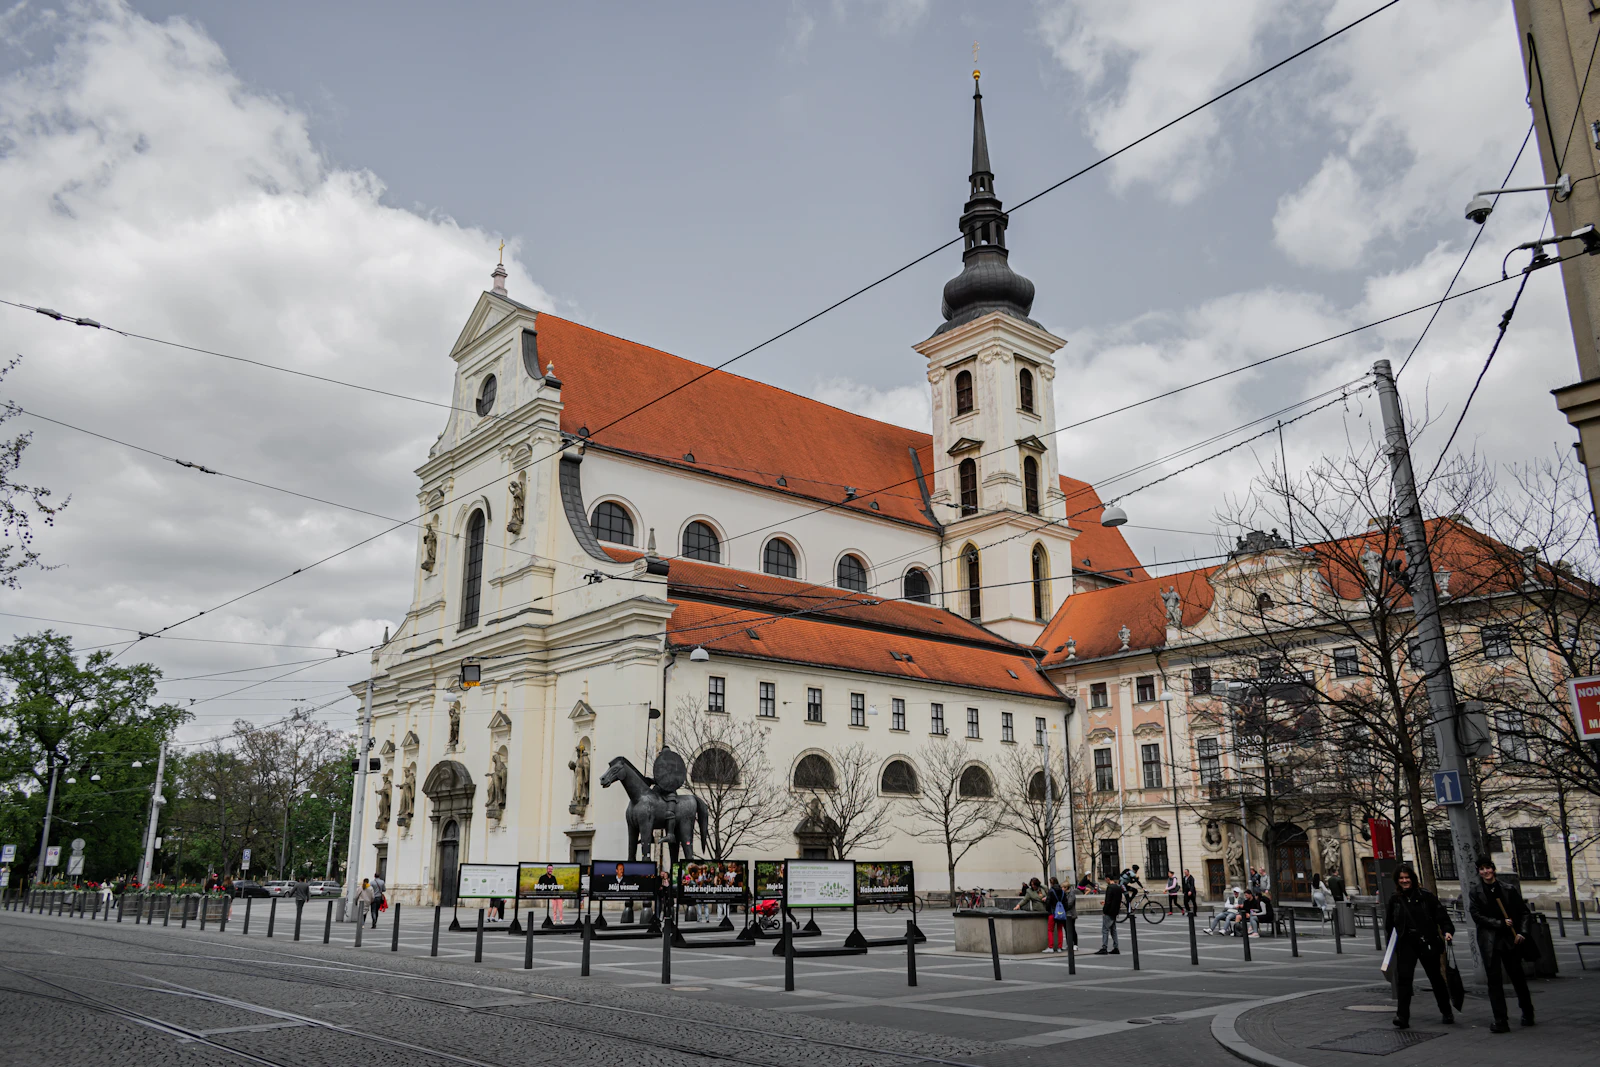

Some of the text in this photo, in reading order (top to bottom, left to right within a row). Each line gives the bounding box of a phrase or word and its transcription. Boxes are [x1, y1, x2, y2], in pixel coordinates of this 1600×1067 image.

[1577, 686, 1600, 698] NON
[548, 882, 564, 890] výzva
[608, 882, 640, 892] Můj vesmír
[684, 884, 699, 892] Naše
[700, 884, 722, 894] nejlepší
[766, 882, 778, 890] Moje
[872, 884, 908, 892] dobrodružství
